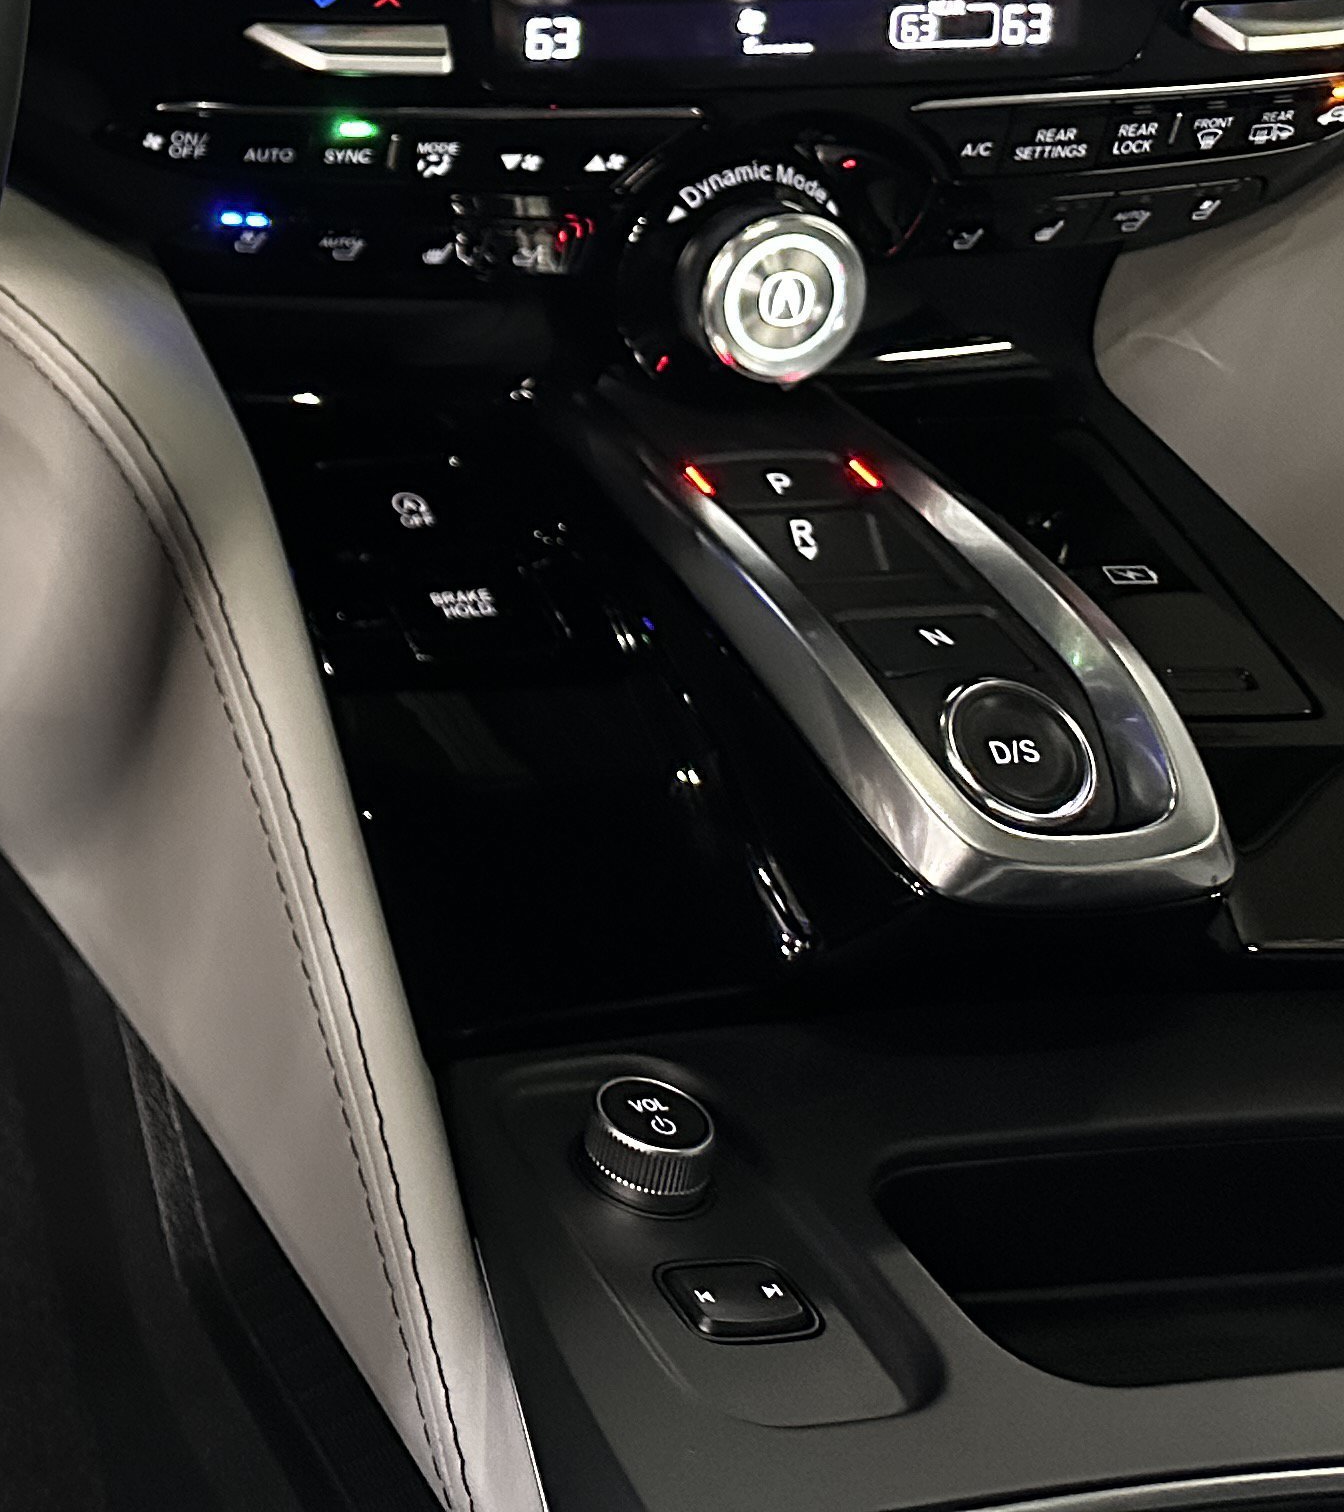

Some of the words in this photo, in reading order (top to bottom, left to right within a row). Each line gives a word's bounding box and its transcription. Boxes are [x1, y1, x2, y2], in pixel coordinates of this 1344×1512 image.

[900, 14, 937, 43] 63
[1002, 3, 1052, 46] 63
[525, 16, 581, 61] 63
[1193, 116, 1235, 130] FRONT
[1261, 109, 1295, 122] REAR
[1035, 128, 1077, 143] REAR
[1118, 122, 1159, 138] REAR
[168, 144, 208, 159] OFF
[243, 147, 297, 163] AUTO
[323, 148, 375, 164] SYNC
[417, 141, 461, 156] MODE
[961, 142, 994, 158] A/C
[1013, 144, 1088, 161] SETTINGS
[1112, 140, 1153, 155] LOCK
[678, 159, 773, 209] Dynamic
[776, 163, 829, 204] Mode
[766, 471, 792, 494] P
[789, 519, 814, 548] R
[429, 588, 495, 607] BRAKE
[442, 602, 498, 619] HOLD
[919, 626, 954, 650] N
[989, 738, 1041, 767] D/S
[627, 1096, 669, 1114] VOL
